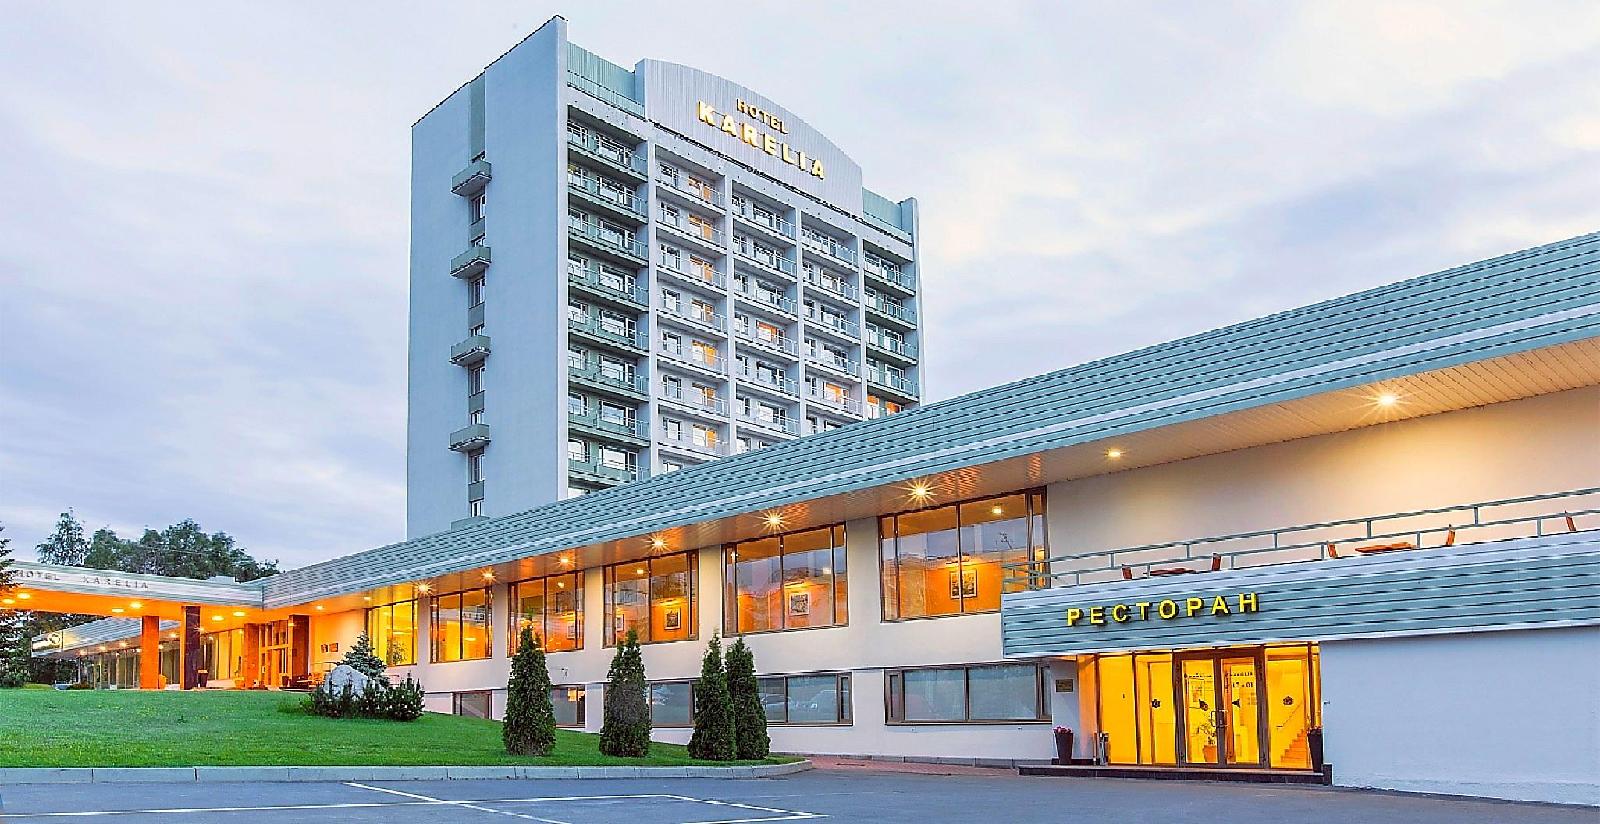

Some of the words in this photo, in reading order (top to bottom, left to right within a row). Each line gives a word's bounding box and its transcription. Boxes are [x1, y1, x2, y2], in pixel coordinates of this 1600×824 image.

[736, 99, 788, 134] HOTEL
[697, 100, 824, 180] KARELIA
[82, 575, 148, 589] KARELIA
[1066, 592, 1259, 627] РЕСТОРАН
